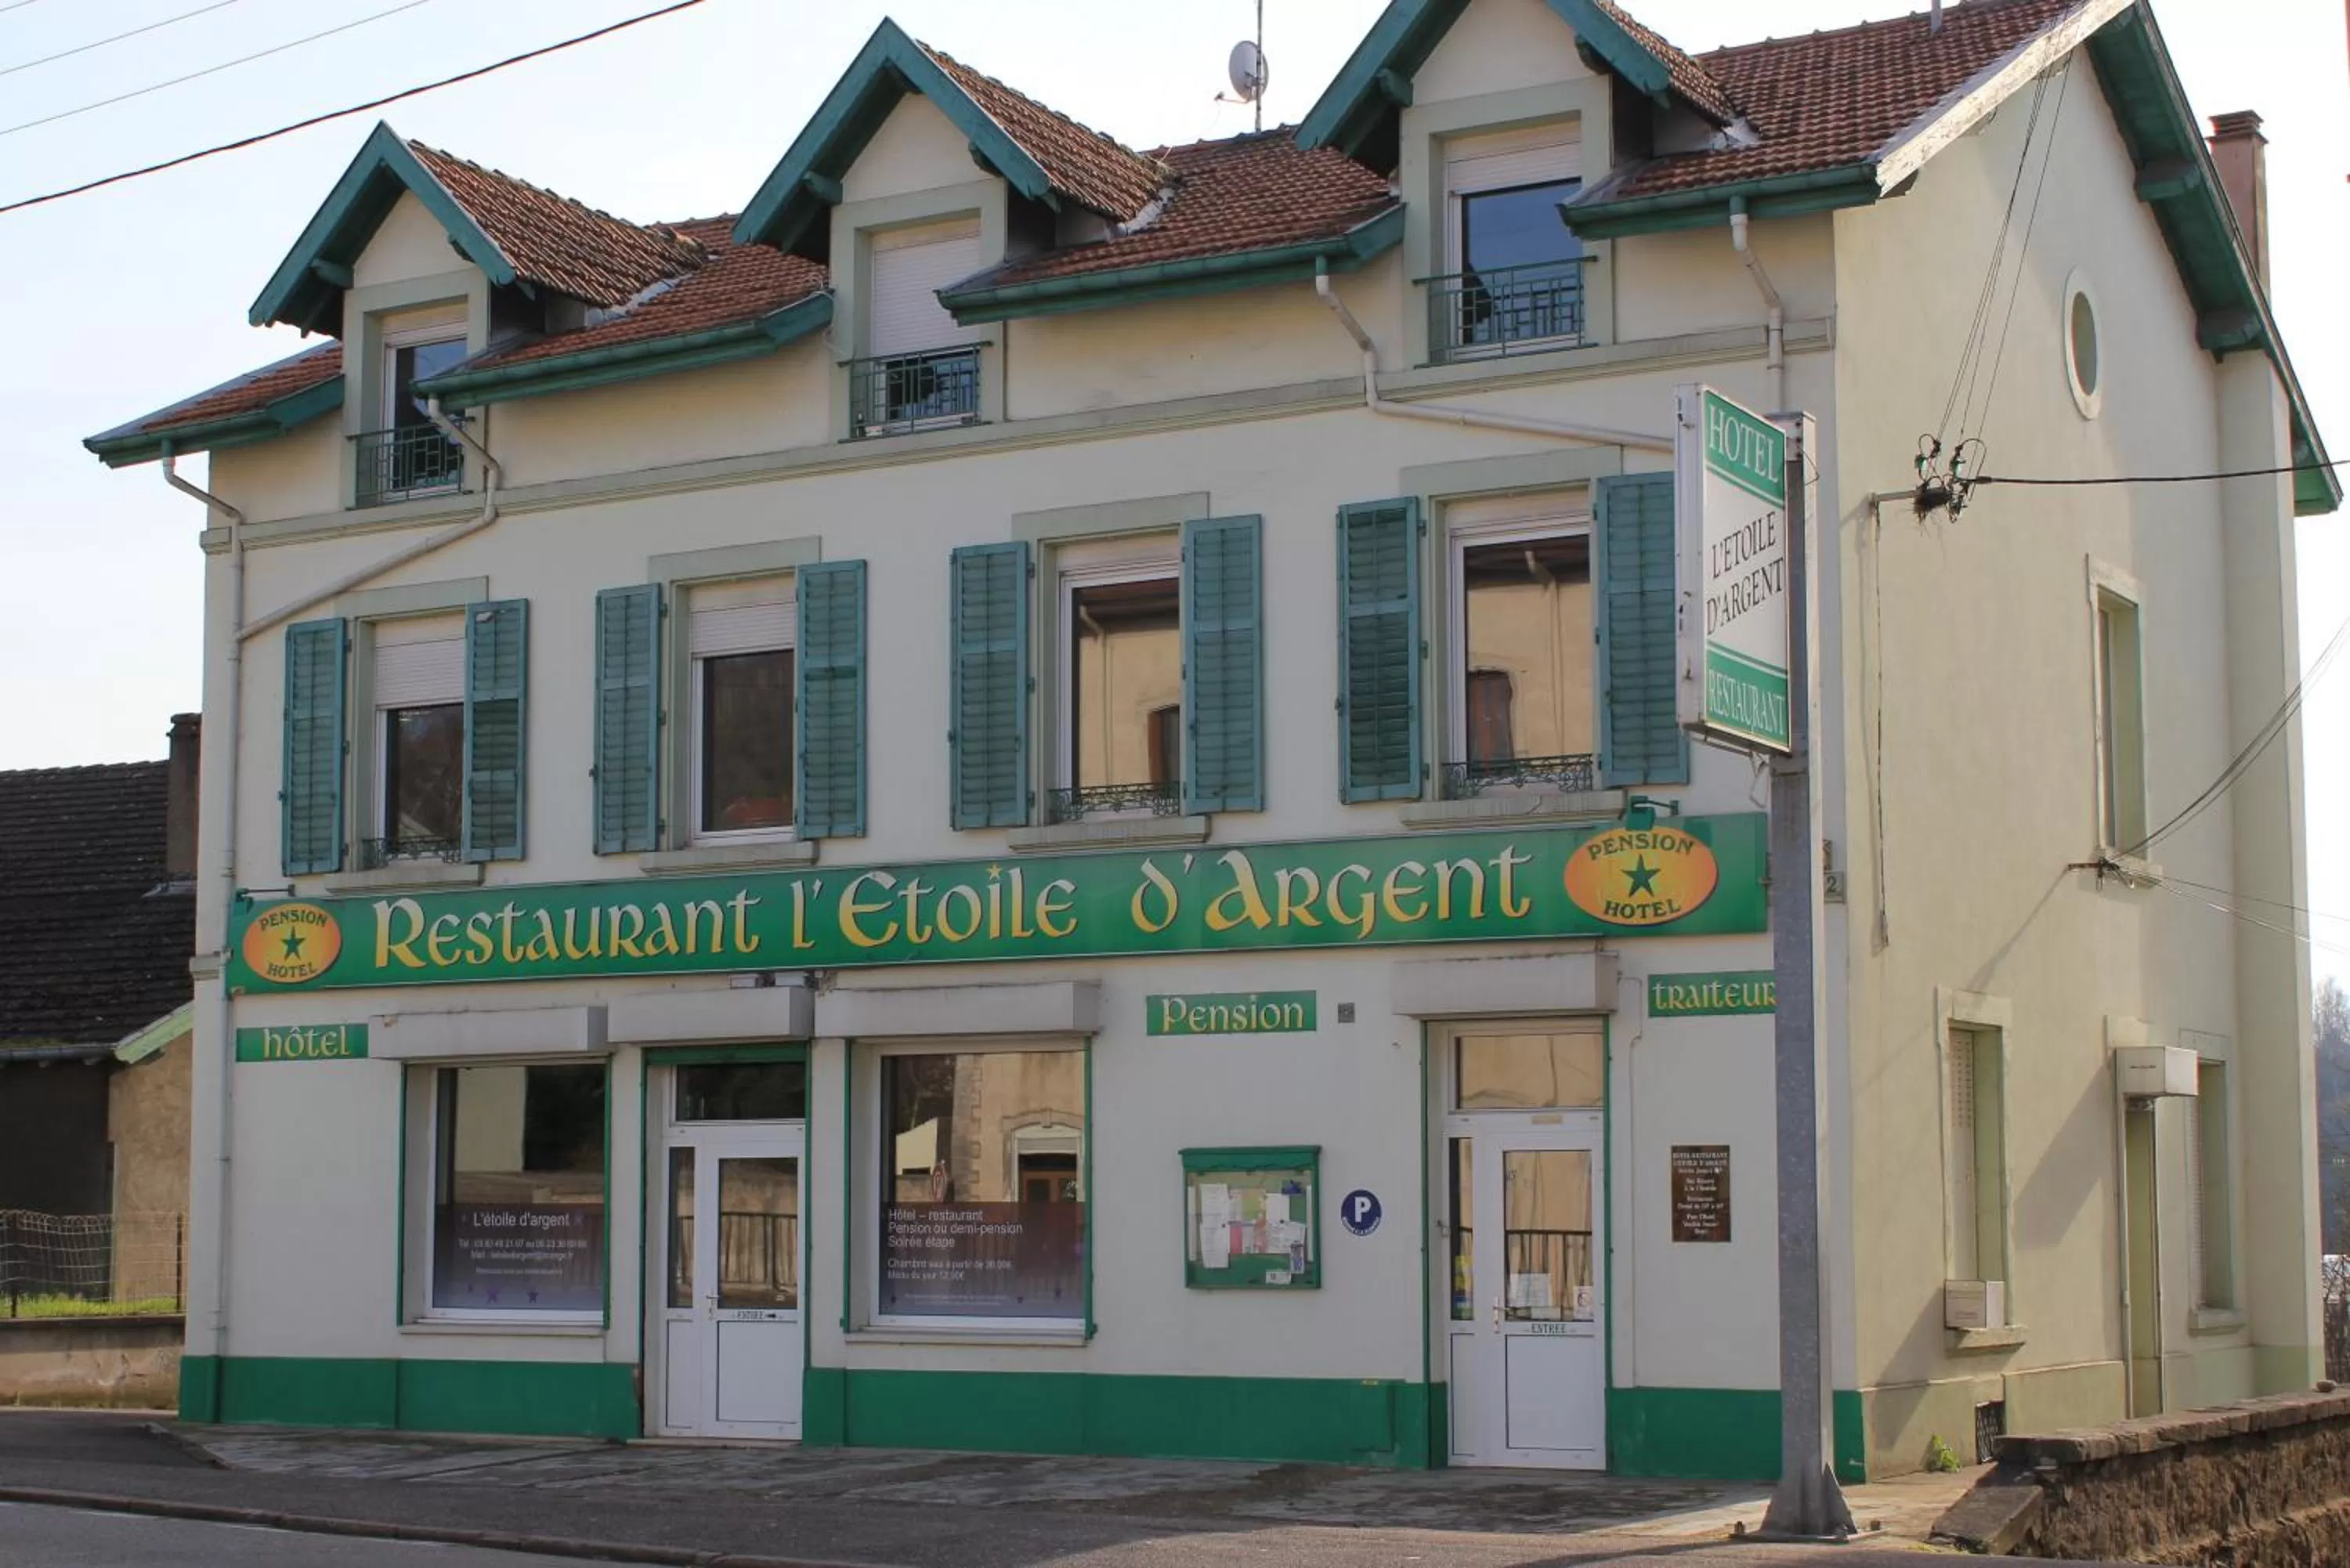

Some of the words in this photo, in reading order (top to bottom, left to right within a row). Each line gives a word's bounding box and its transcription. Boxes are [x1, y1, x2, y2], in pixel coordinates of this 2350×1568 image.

[1708, 405, 1779, 483] HOTEL
[1712, 511, 1776, 580] L'ETOILE
[1708, 557, 1784, 636] D'ARGENT
[1708, 669, 1784, 736] RESTAURANT
[1587, 833, 1694, 861] PENSION
[259, 909, 328, 931] PENSION
[372, 889, 763, 969] Restaurant
[1130, 846, 1534, 940] d'Argent
[1603, 898, 1681, 919] HOTEL
[267, 962, 317, 978] HOTEL
[1162, 994, 1303, 1033] Pension
[263, 1025, 351, 1058] hôtel
[473, 1212, 516, 1227] L'étoile
[519, 1212, 570, 1230] d'argent
[888, 1209, 916, 1221] Hôtel
[928, 1209, 983, 1221] restaurant
[1354, 1196, 1372, 1223] P
[888, 1222, 931, 1235] Pension
[950, 1222, 1024, 1237] demi-pension
